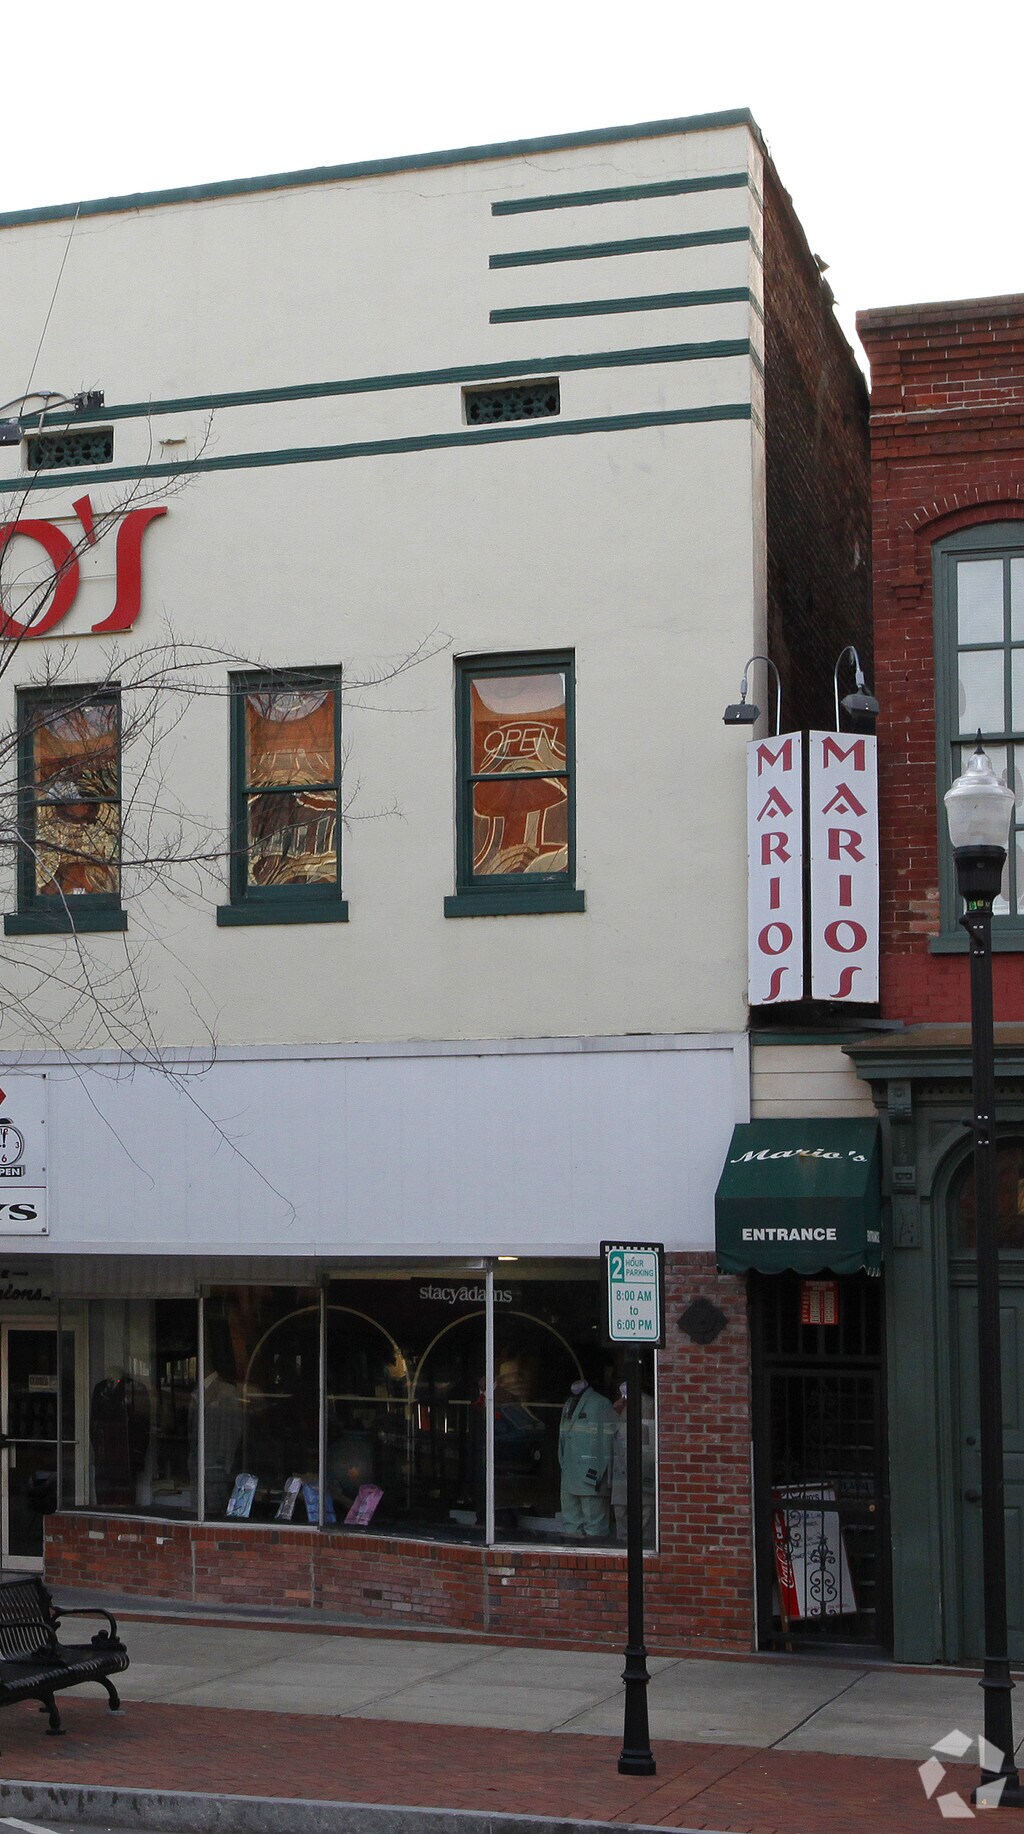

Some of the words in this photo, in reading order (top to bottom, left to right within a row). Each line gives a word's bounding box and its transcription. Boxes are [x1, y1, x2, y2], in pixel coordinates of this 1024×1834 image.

[483, 727, 558, 754] OPEN
[756, 738, 794, 1001] MARIOS
[821, 736, 868, 999] MARIOS
[730, 1148, 868, 1163] Mario's
[742, 1228, 837, 1241] ENTRANCE
[611, 1256, 623, 1280] 2
[625, 1259, 644, 1267] HOUR
[625, 1269, 654, 1277] PARKING
[616, 1290, 635, 1301] 8:00
[637, 1290, 652, 1301] AM
[629, 1306, 639, 1315] to
[617, 1320, 636, 1330] 6:00
[638, 1320, 652, 1330] PM
